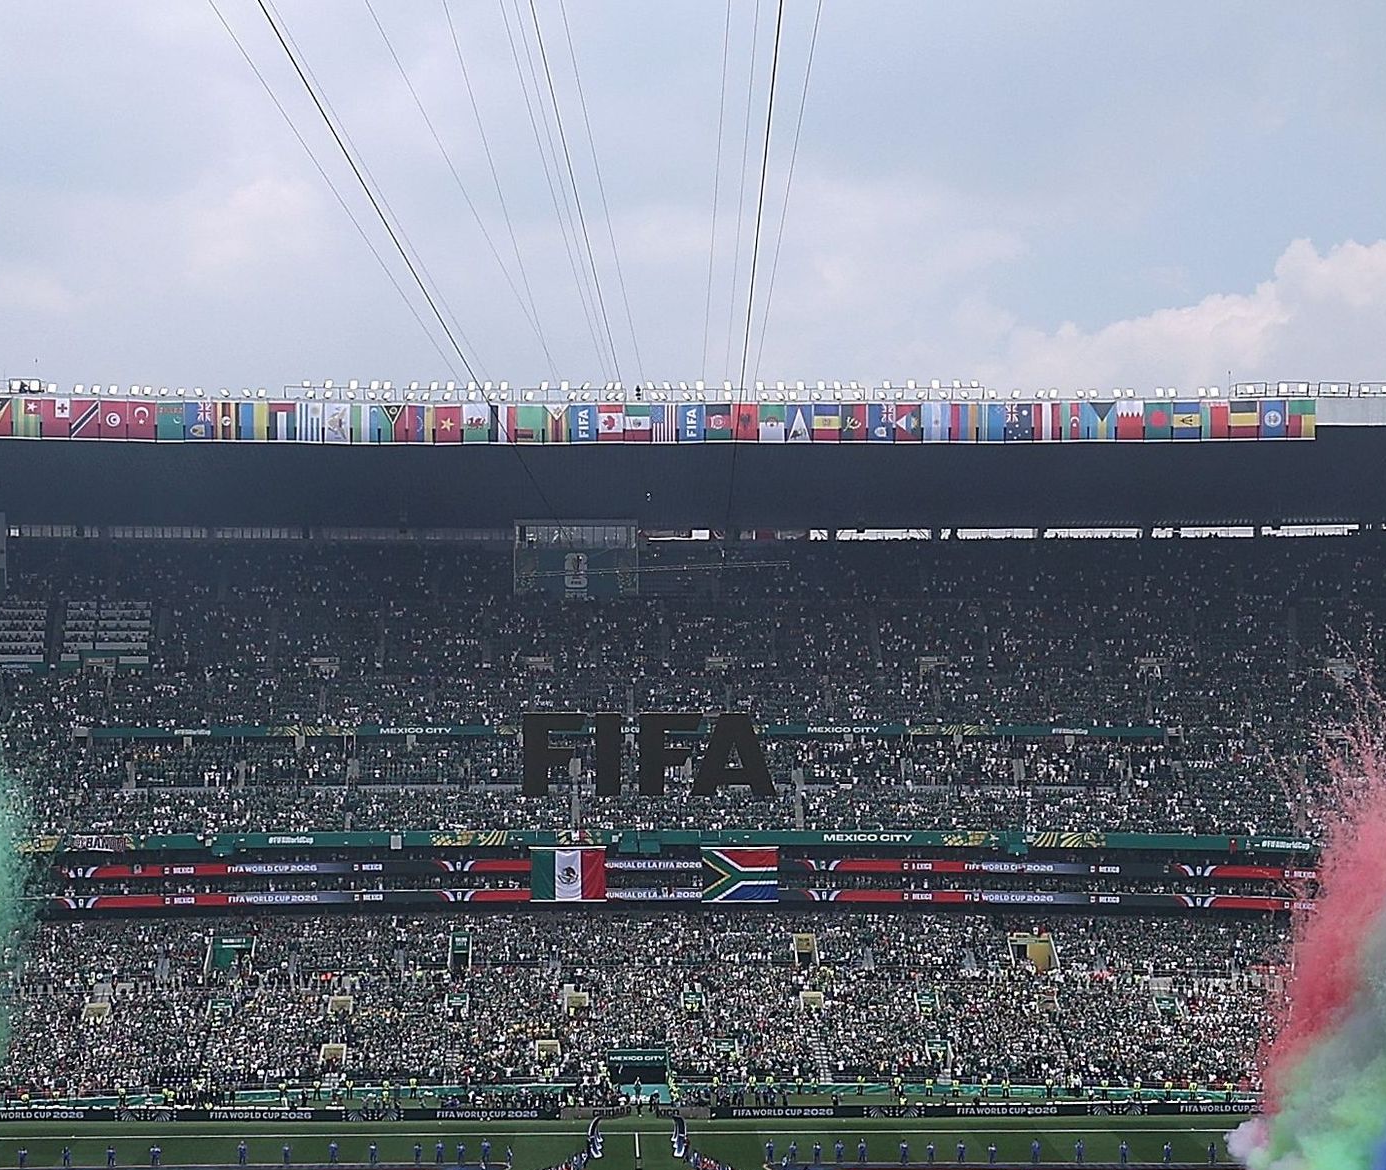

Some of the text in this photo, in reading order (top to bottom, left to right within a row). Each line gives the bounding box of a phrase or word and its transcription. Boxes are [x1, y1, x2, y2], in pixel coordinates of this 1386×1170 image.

[425, 727, 452, 735] CITY
[807, 726, 879, 734] MEXICO CITY
[522, 712, 777, 797] FIFA
[823, 833, 913, 843] MEXICO CITY
[227, 865, 244, 873] FIFA
[245, 865, 273, 873] WORLD
[291, 864, 317, 872] 2026
[1026, 864, 1054, 872] 2026
[228, 896, 245, 904] FIFA
[246, 895, 274, 903] WORLD
[291, 894, 318, 902] 2026
[676, 891, 703, 899] 2026
[982, 894, 1054, 902] WORLD CUP 2026
[644, 1054, 665, 1062] CITY
[732, 1108, 834, 1116] FIFA WORLD CUP 2026
[956, 1107, 1058, 1116] FIFA WORLD CUP 2026
[1179, 1104, 1250, 1113] FIFA WORLD CUP
[0, 1111, 85, 1120] WORLD CUP 2026
[209, 1111, 312, 1120] FIFA WORLD CUP 2026
[436, 1110, 538, 1119] FIFA WORLD CUP 2026
